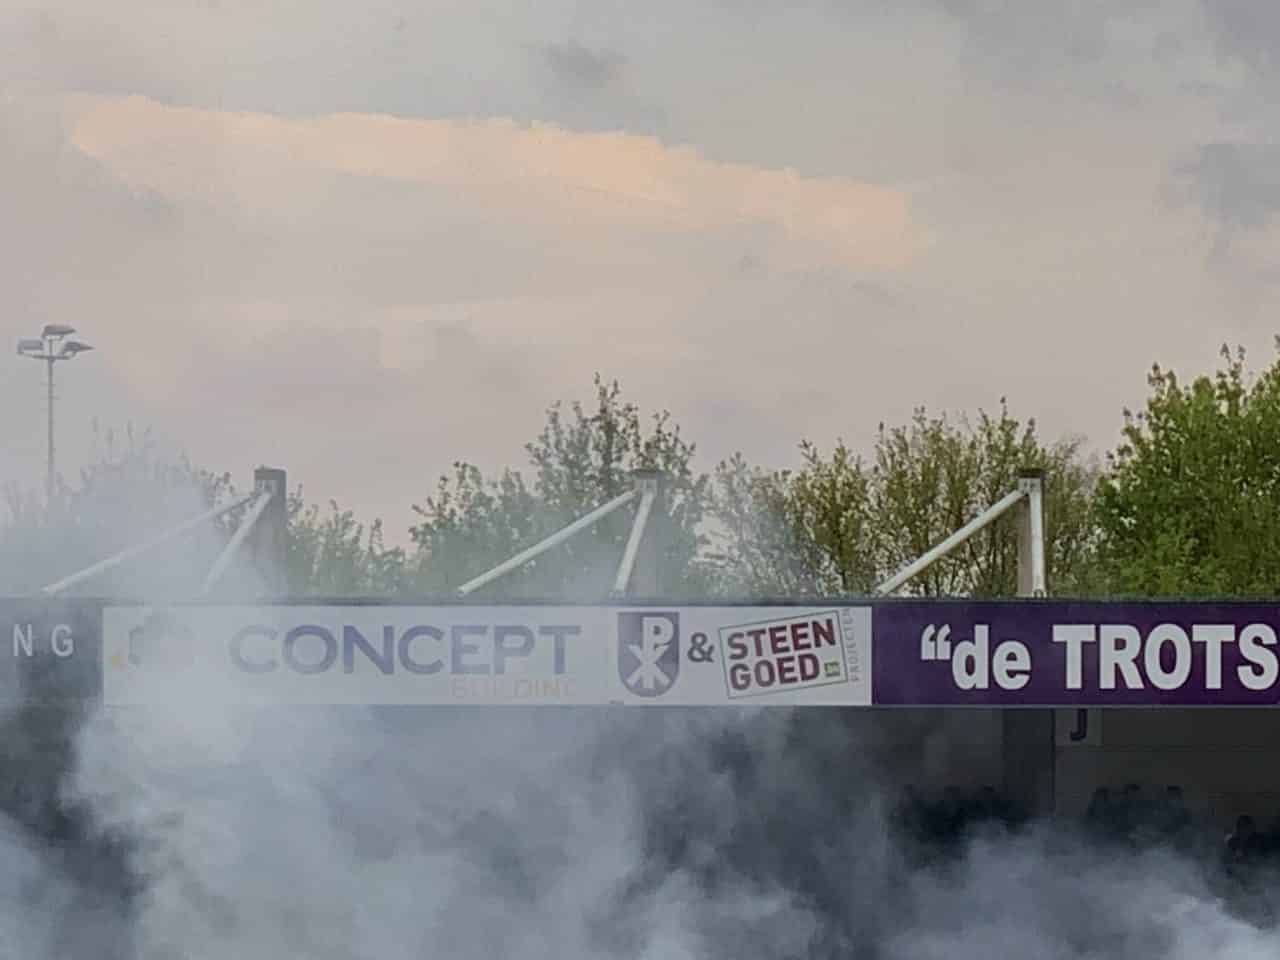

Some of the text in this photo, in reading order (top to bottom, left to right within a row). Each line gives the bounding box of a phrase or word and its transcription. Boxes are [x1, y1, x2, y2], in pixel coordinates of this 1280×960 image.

[229, 624, 582, 675] CONCEPT
[687, 632, 714, 663] &
[727, 618, 836, 660] STEEN
[1053, 624, 1280, 691] TROTS
[729, 653, 820, 691] GOED
